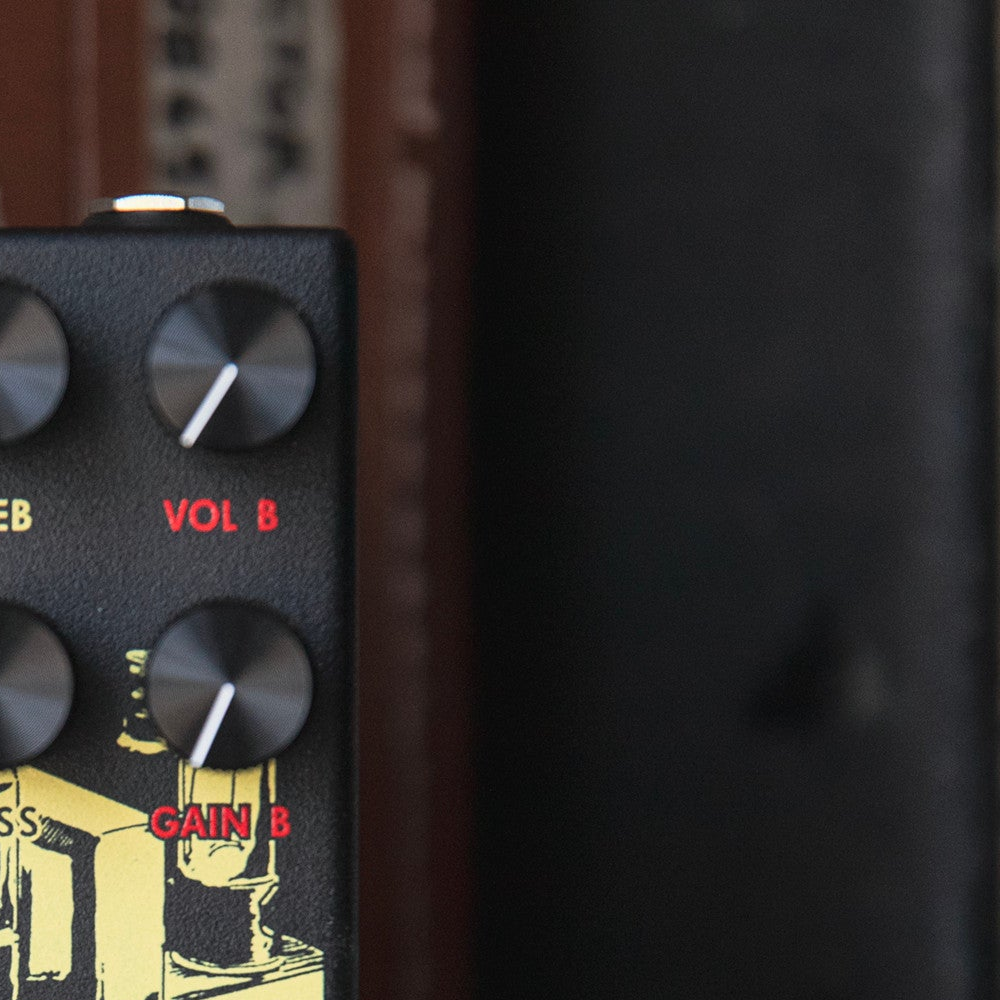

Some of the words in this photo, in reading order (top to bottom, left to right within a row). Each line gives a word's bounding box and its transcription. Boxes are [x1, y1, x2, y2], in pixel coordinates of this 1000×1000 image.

[163, 499, 237, 532] VOL
[258, 499, 279, 532] B
[151, 805, 249, 839] GAIN
[270, 805, 291, 838] B
